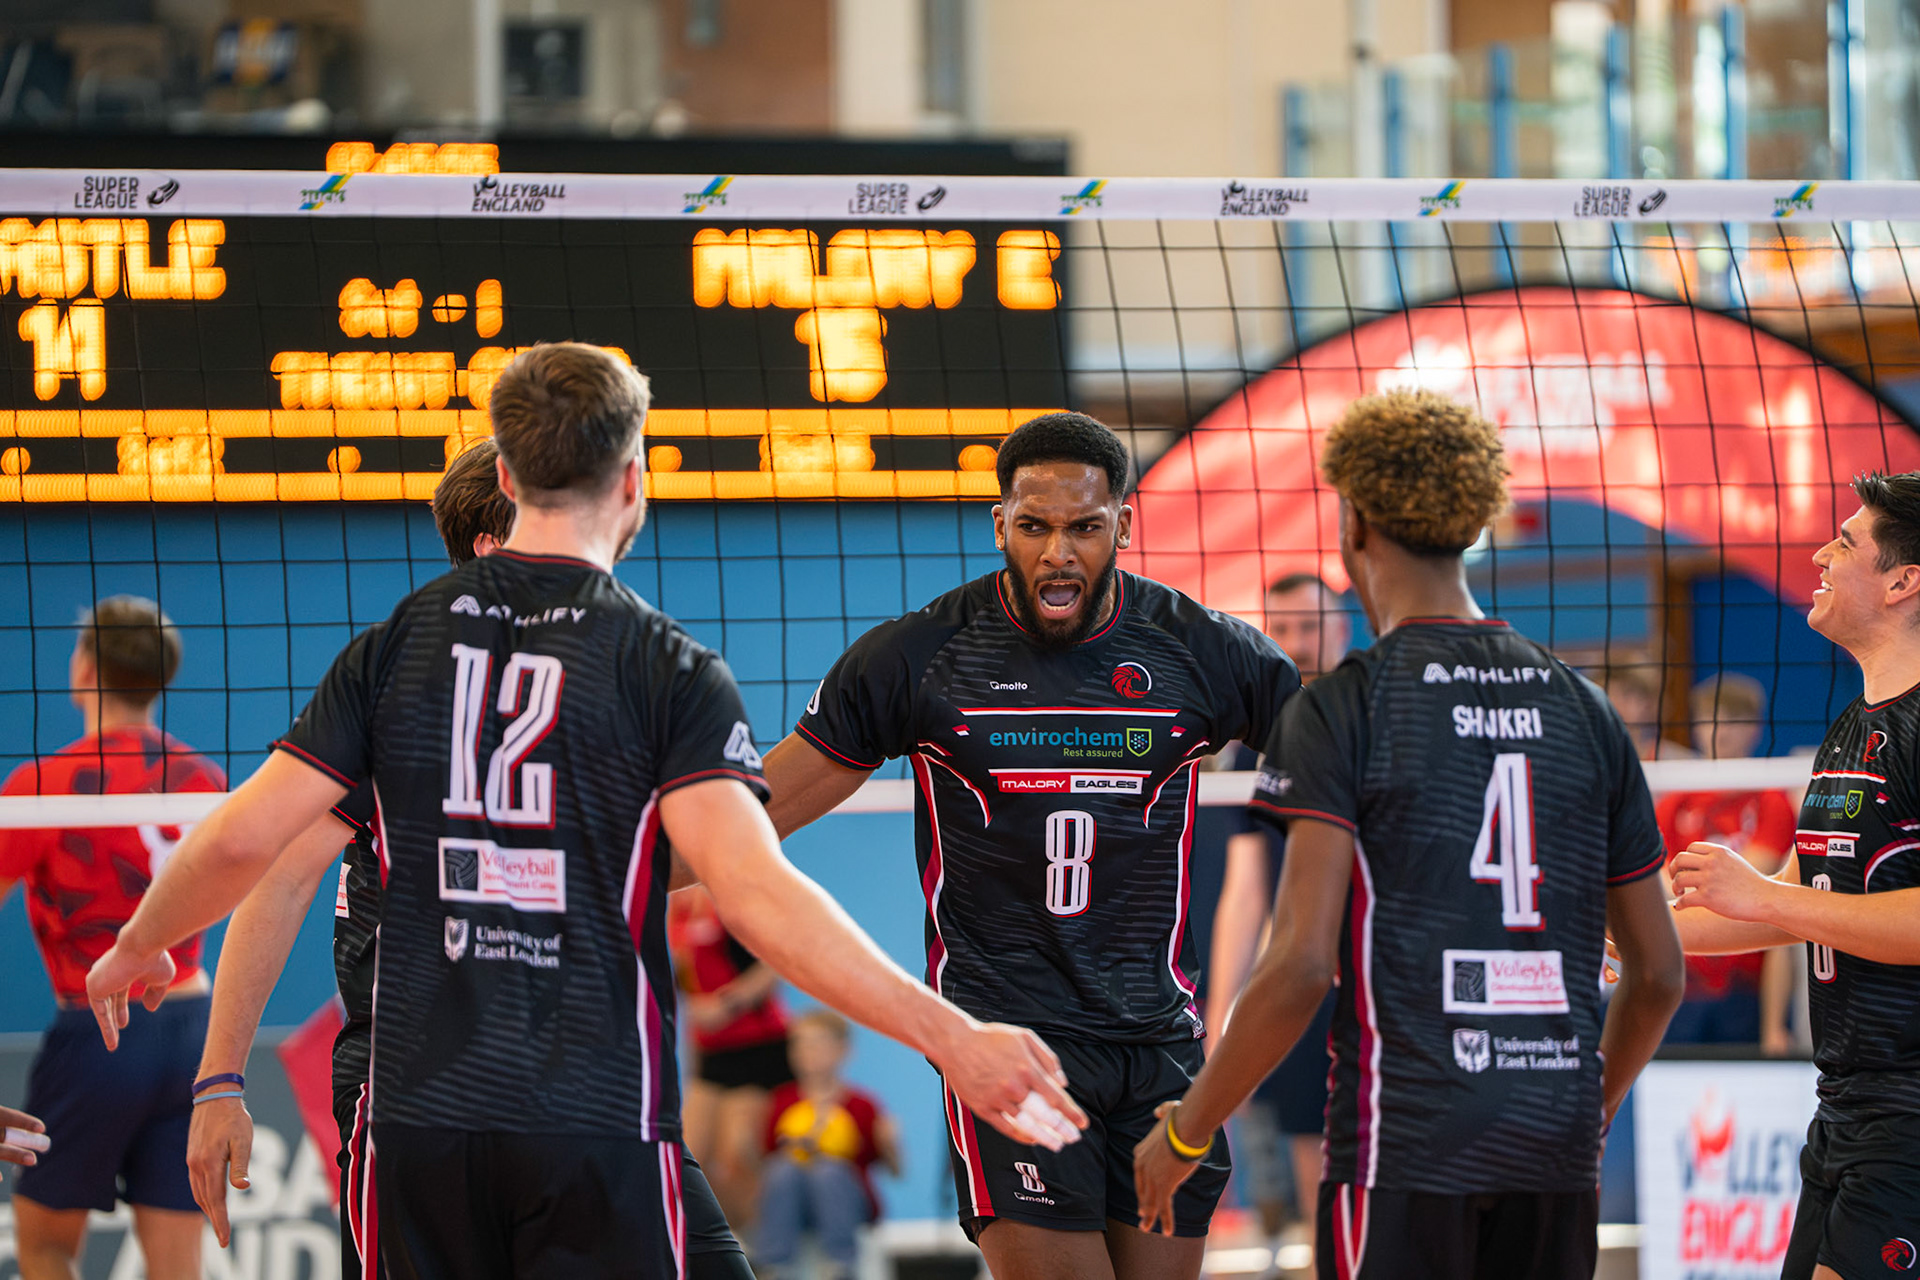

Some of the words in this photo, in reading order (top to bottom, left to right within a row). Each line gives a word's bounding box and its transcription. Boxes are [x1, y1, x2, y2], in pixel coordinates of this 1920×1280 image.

[83, 176, 139, 192] SUPER
[856, 183, 909, 198] SUPER
[74, 192, 139, 208] LEAGUE
[1582, 186, 1631, 201] SUPER
[471, 198, 545, 212] ENGLAND
[848, 199, 908, 214] LEAGUE
[1220, 202, 1290, 216] ENGLAND
[1573, 201, 1630, 217] LEAGUE
[1452, 664, 1552, 684] ATHLIFY
[442, 642, 566, 829] 12
[989, 726, 1124, 747] envirochem
[1063, 748, 1084, 757] Rest
[1086, 749, 1123, 758] assured
[1002, 780, 1066, 788] MALORY
[1075, 780, 1138, 789] EAGLES
[1470, 752, 1546, 931] 4
[481, 849, 555, 879] Voleyball
[1045, 810, 1096, 917] 8
[543, 933, 562, 952] of
[475, 943, 507, 959] East
[1493, 1036, 1563, 1057] University
[1563, 1034, 1580, 1053] of
[1496, 1053, 1528, 1070] East
[1529, 1053, 1582, 1070] London
[1014, 1161, 1047, 1193] 8
